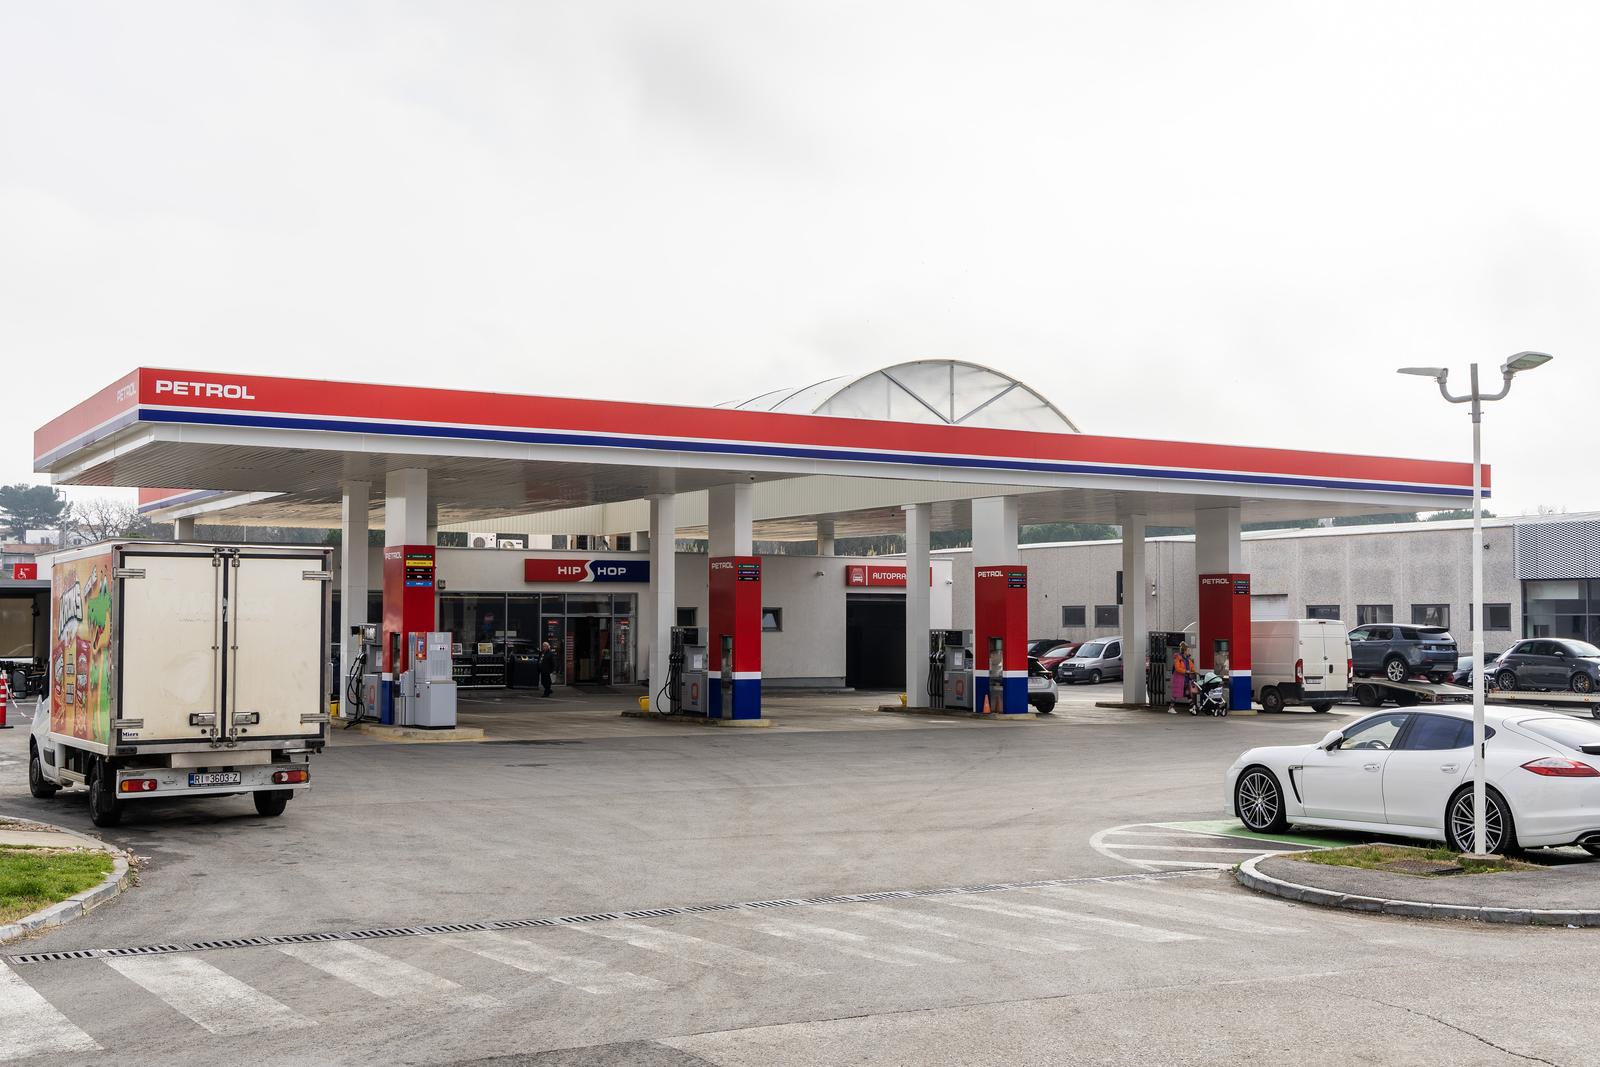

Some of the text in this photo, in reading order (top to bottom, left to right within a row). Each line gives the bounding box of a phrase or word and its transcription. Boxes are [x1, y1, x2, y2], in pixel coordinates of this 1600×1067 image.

[116, 382, 136, 402] PETROL
[155, 380, 255, 400] PETROL
[557, 566, 582, 575] HIP
[195, 773, 238, 784] RI 3603-Z
